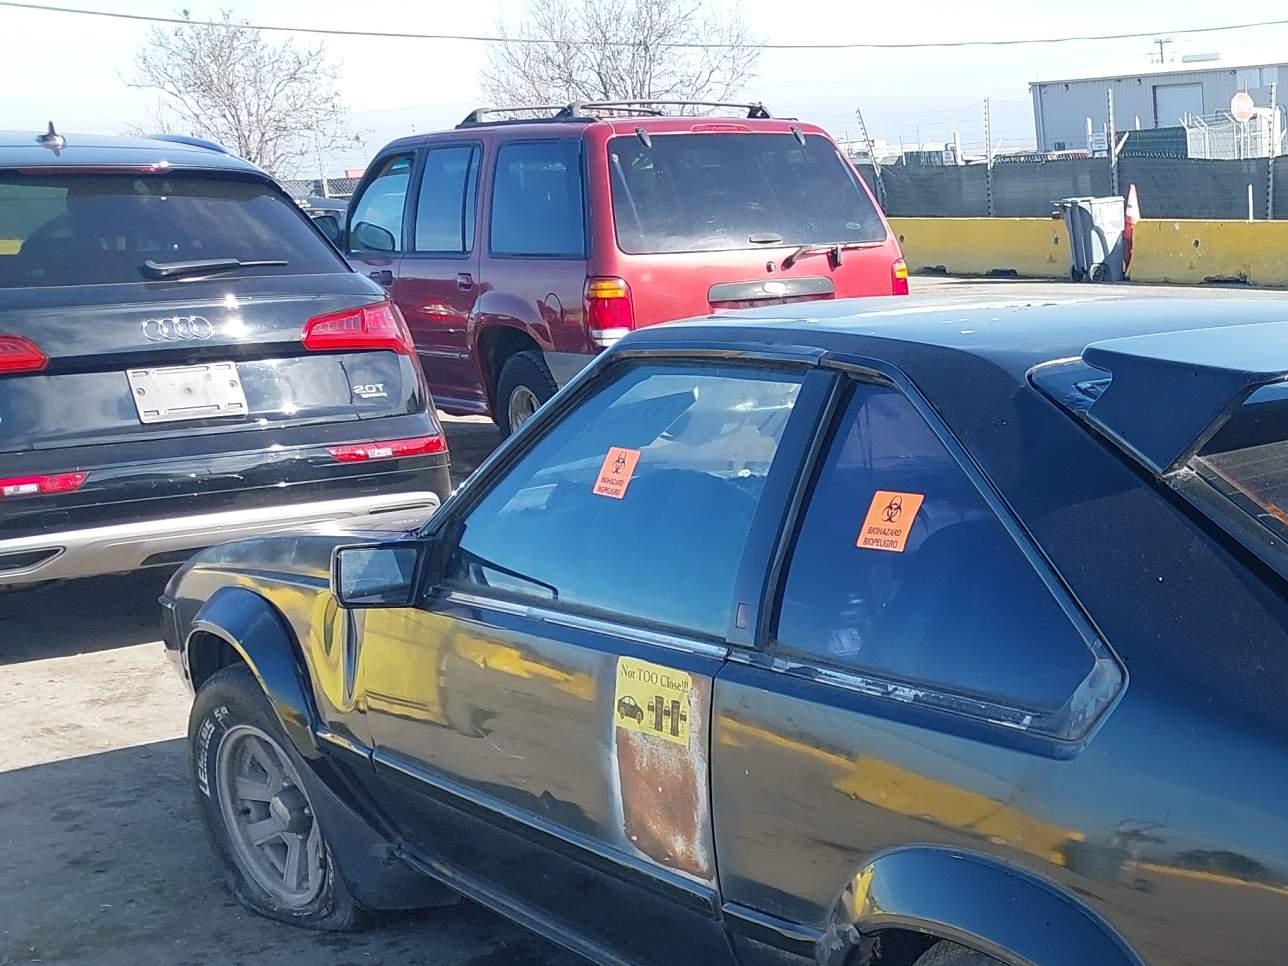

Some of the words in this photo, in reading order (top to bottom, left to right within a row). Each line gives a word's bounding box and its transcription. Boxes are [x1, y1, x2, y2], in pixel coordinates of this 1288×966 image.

[867, 526, 902, 537] BIOHAZARD
[863, 537, 898, 549] BIOPELIGRO
[621, 663, 636, 679] Not
[637, 668, 658, 685] TOO
